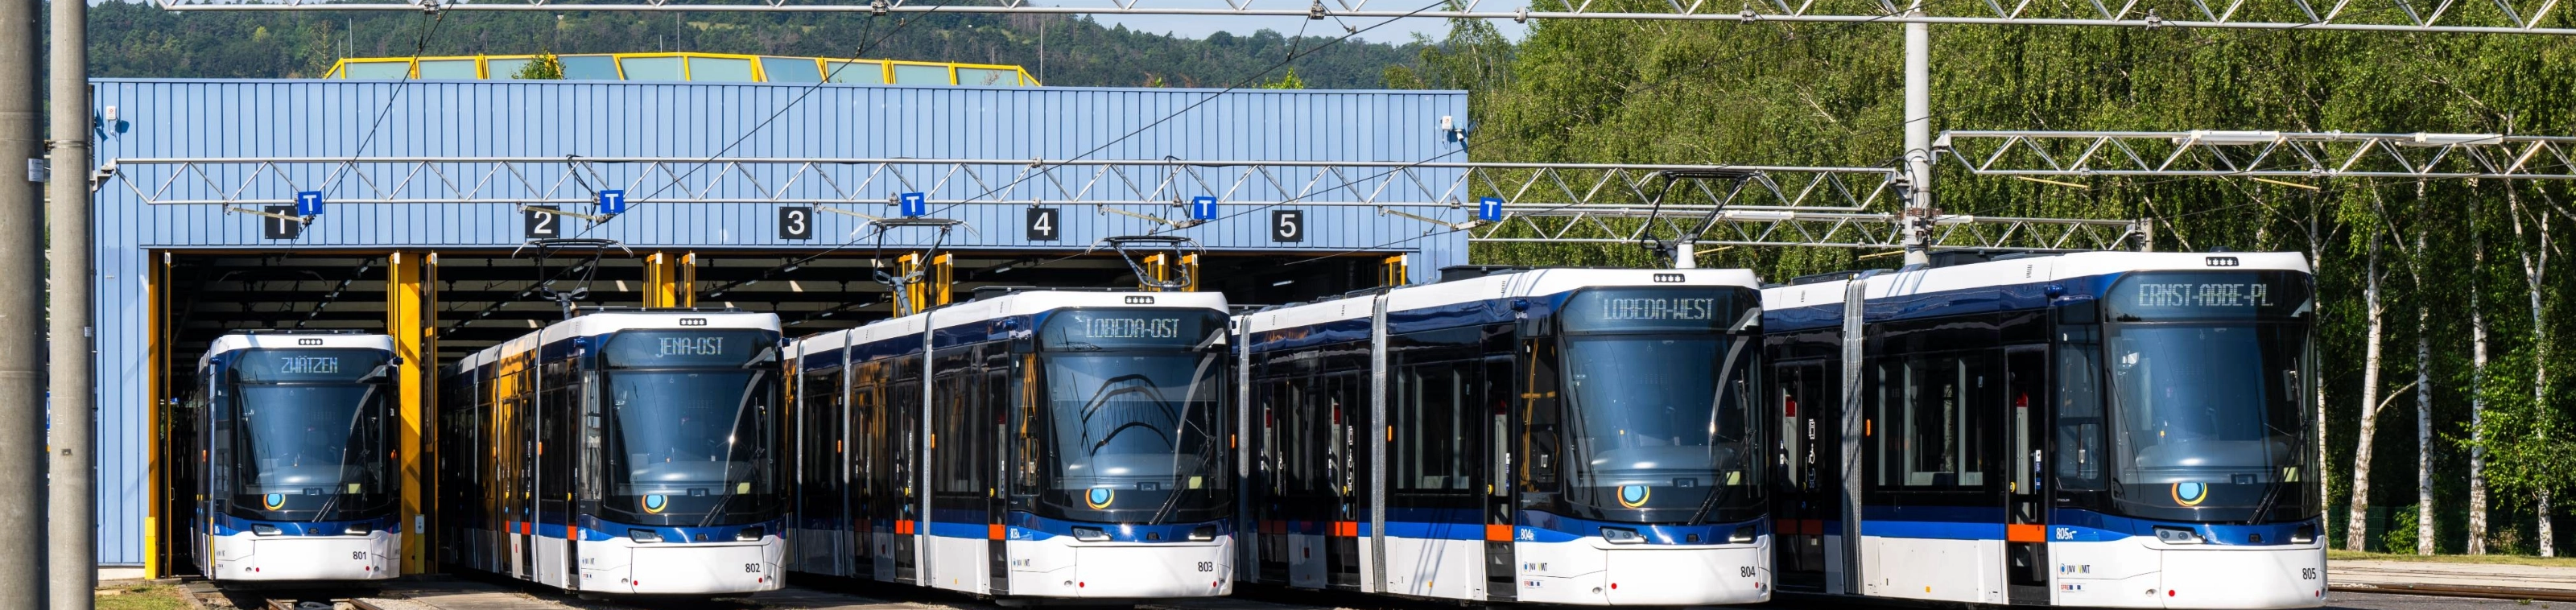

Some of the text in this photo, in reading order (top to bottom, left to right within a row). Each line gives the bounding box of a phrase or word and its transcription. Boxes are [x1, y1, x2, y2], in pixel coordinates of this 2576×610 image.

[303, 194, 317, 212] T
[605, 193, 619, 210] T
[906, 196, 920, 212] T
[1199, 200, 1212, 216] T
[1484, 200, 1497, 217] T
[278, 209, 285, 234] 1
[534, 211, 552, 234] 2
[787, 210, 805, 235] 3
[1034, 212, 1051, 236] 4
[1279, 213, 1296, 238] 5
[2138, 283, 2274, 307] ERNST-ABBE-PL.
[1604, 298, 1715, 319] LOBEDA-WEST
[1086, 318, 1180, 338] LOBEDA-OST
[655, 336, 724, 358] JENA-OST
[281, 355, 338, 373] ZWÄTZEN
[353, 550, 366, 560] 801
[745, 563, 761, 573] 802
[1198, 561, 1213, 572] 803
[1740, 566, 1756, 578] 804
[2302, 567, 2317, 580] 805
